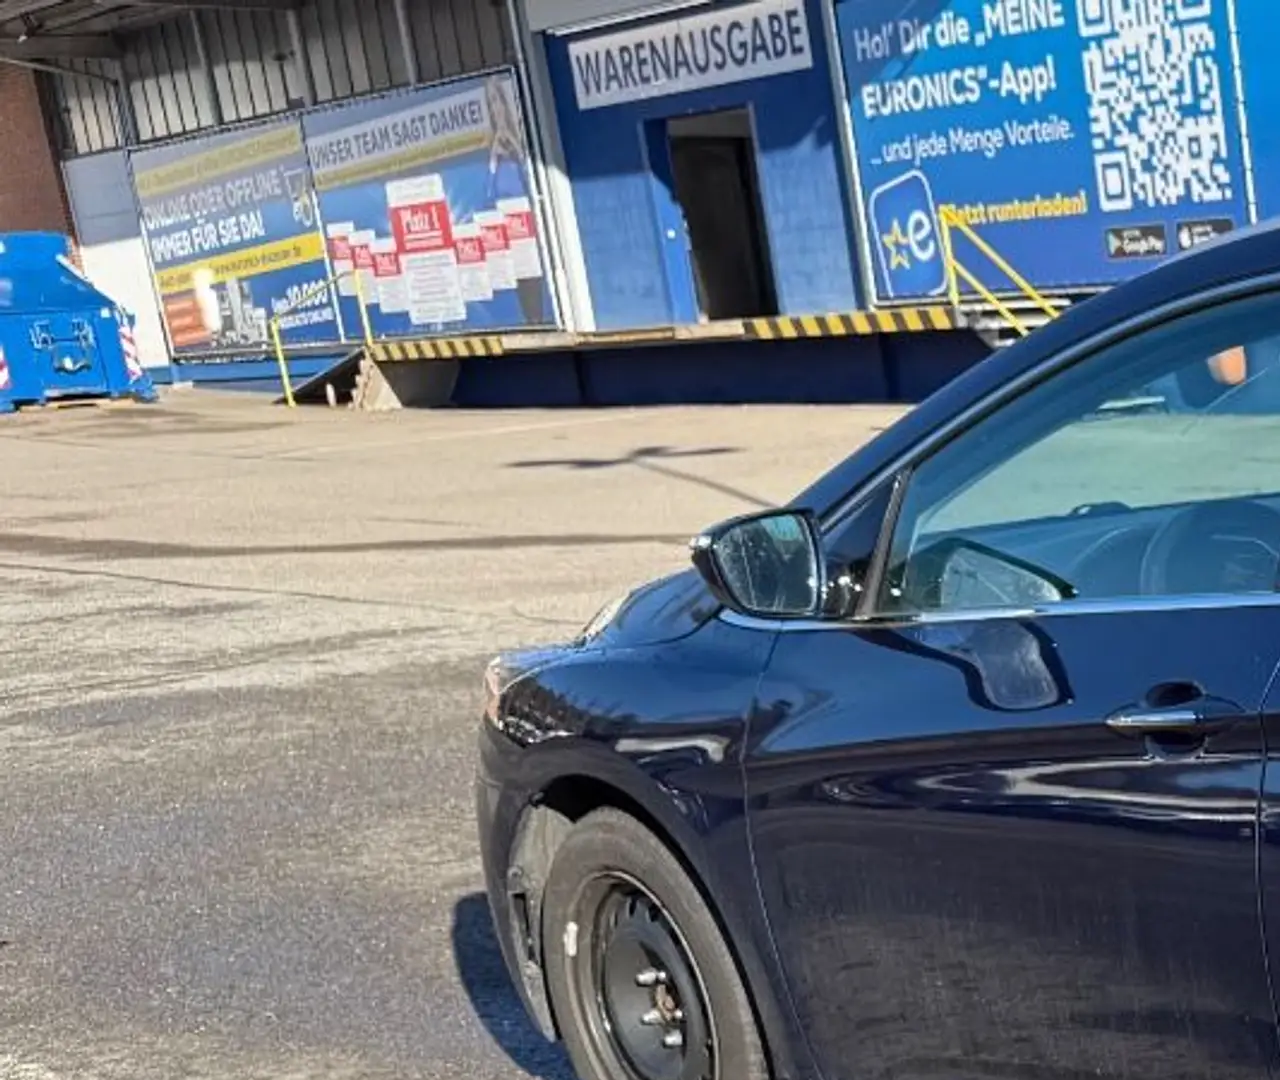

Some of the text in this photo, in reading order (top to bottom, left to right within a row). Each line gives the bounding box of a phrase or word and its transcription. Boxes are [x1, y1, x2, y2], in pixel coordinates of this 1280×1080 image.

[575, 9, 805, 97] WARENAUSGABE
[898, 19, 930, 54] Dir
[935, 12, 969, 46] die
[310, 134, 353, 169] UNSER
[354, 124, 389, 154] TEAM
[391, 115, 427, 146] SAGT
[428, 100, 484, 136] DANKE!
[914, 130, 947, 166] jede
[948, 123, 1006, 158] Menge
[192, 217, 220, 252] FÜR
[219, 216, 241, 246] SIE
